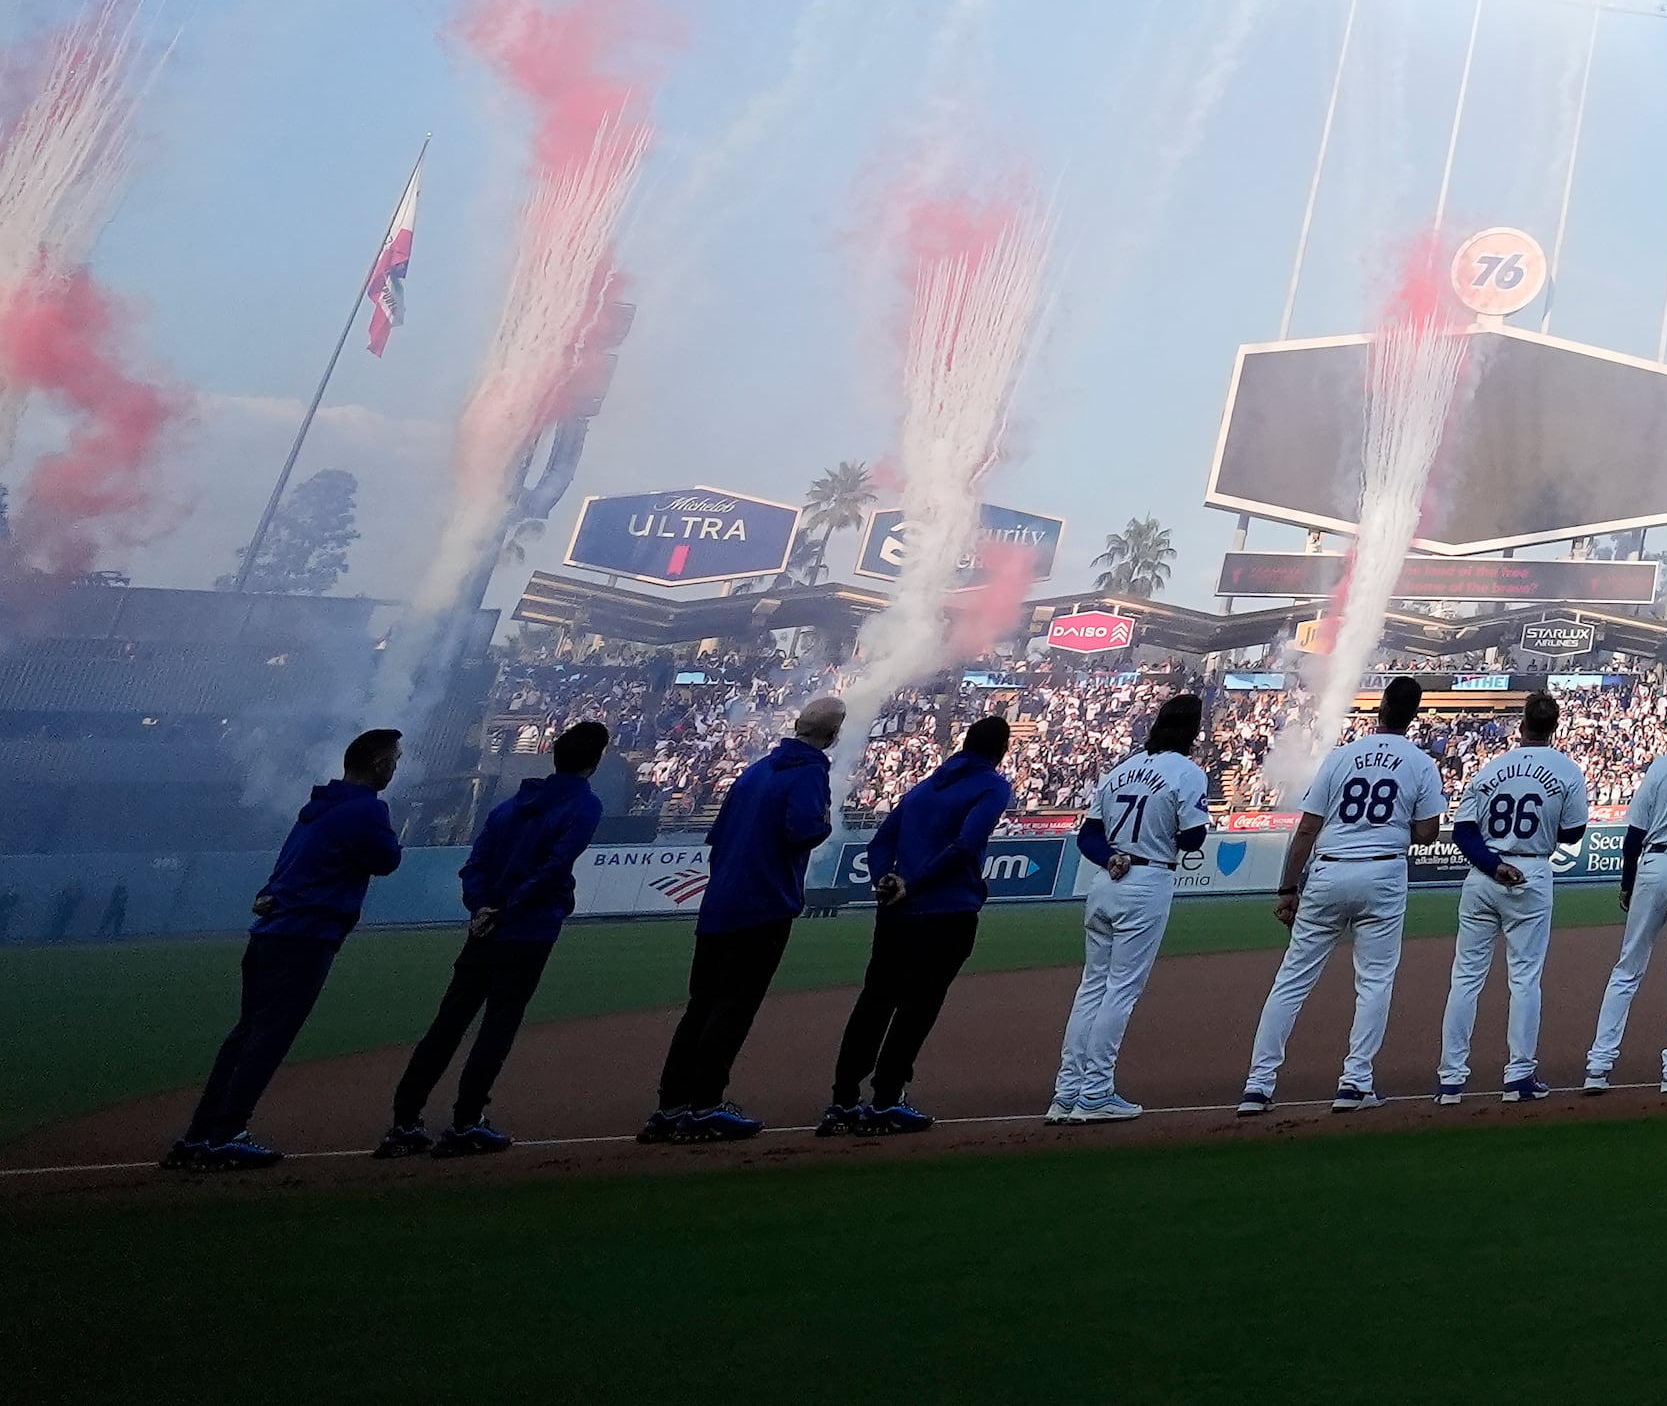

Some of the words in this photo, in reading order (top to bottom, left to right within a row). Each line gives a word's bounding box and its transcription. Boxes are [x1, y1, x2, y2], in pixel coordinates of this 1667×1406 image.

[1471, 253, 1524, 290] 76
[653, 495, 738, 513] Michelob
[628, 514, 746, 541] ULTRA
[980, 523, 1046, 546] urity
[1053, 625, 1107, 638] DAISO
[1525, 627, 1589, 640] STARLUX
[1535, 638, 1579, 647] AIRLINES
[1354, 752, 1403, 772] GEREN
[1109, 768, 1167, 795] LEHMANN
[1338, 777, 1400, 824] 88
[1109, 794, 1149, 844] 71
[1487, 793, 1544, 840] 86
[594, 852, 656, 866] BANK
[660, 852, 687, 865] OF
[1586, 853, 1624, 872] Ben
